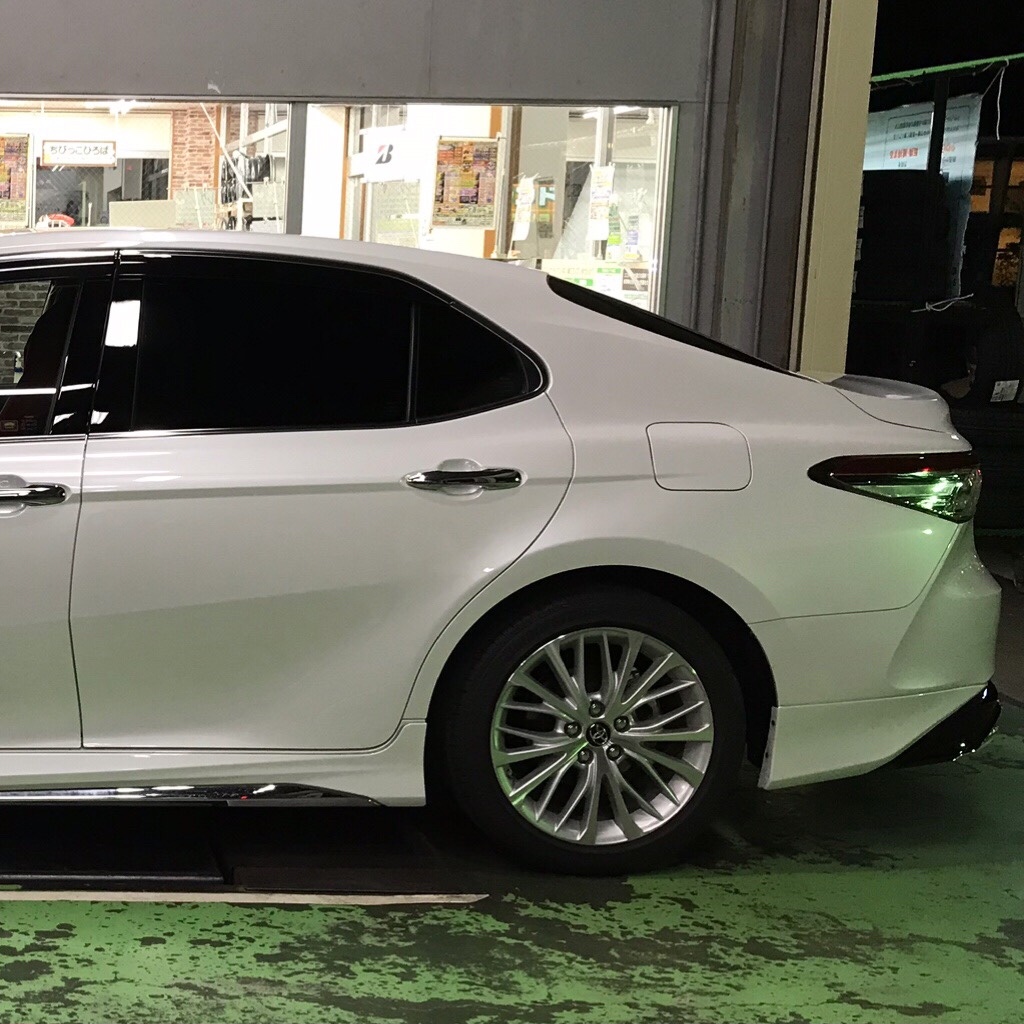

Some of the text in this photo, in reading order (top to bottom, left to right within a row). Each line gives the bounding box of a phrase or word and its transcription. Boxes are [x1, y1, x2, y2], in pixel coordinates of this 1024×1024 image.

[49, 144, 109, 155] ちびっこひろば
